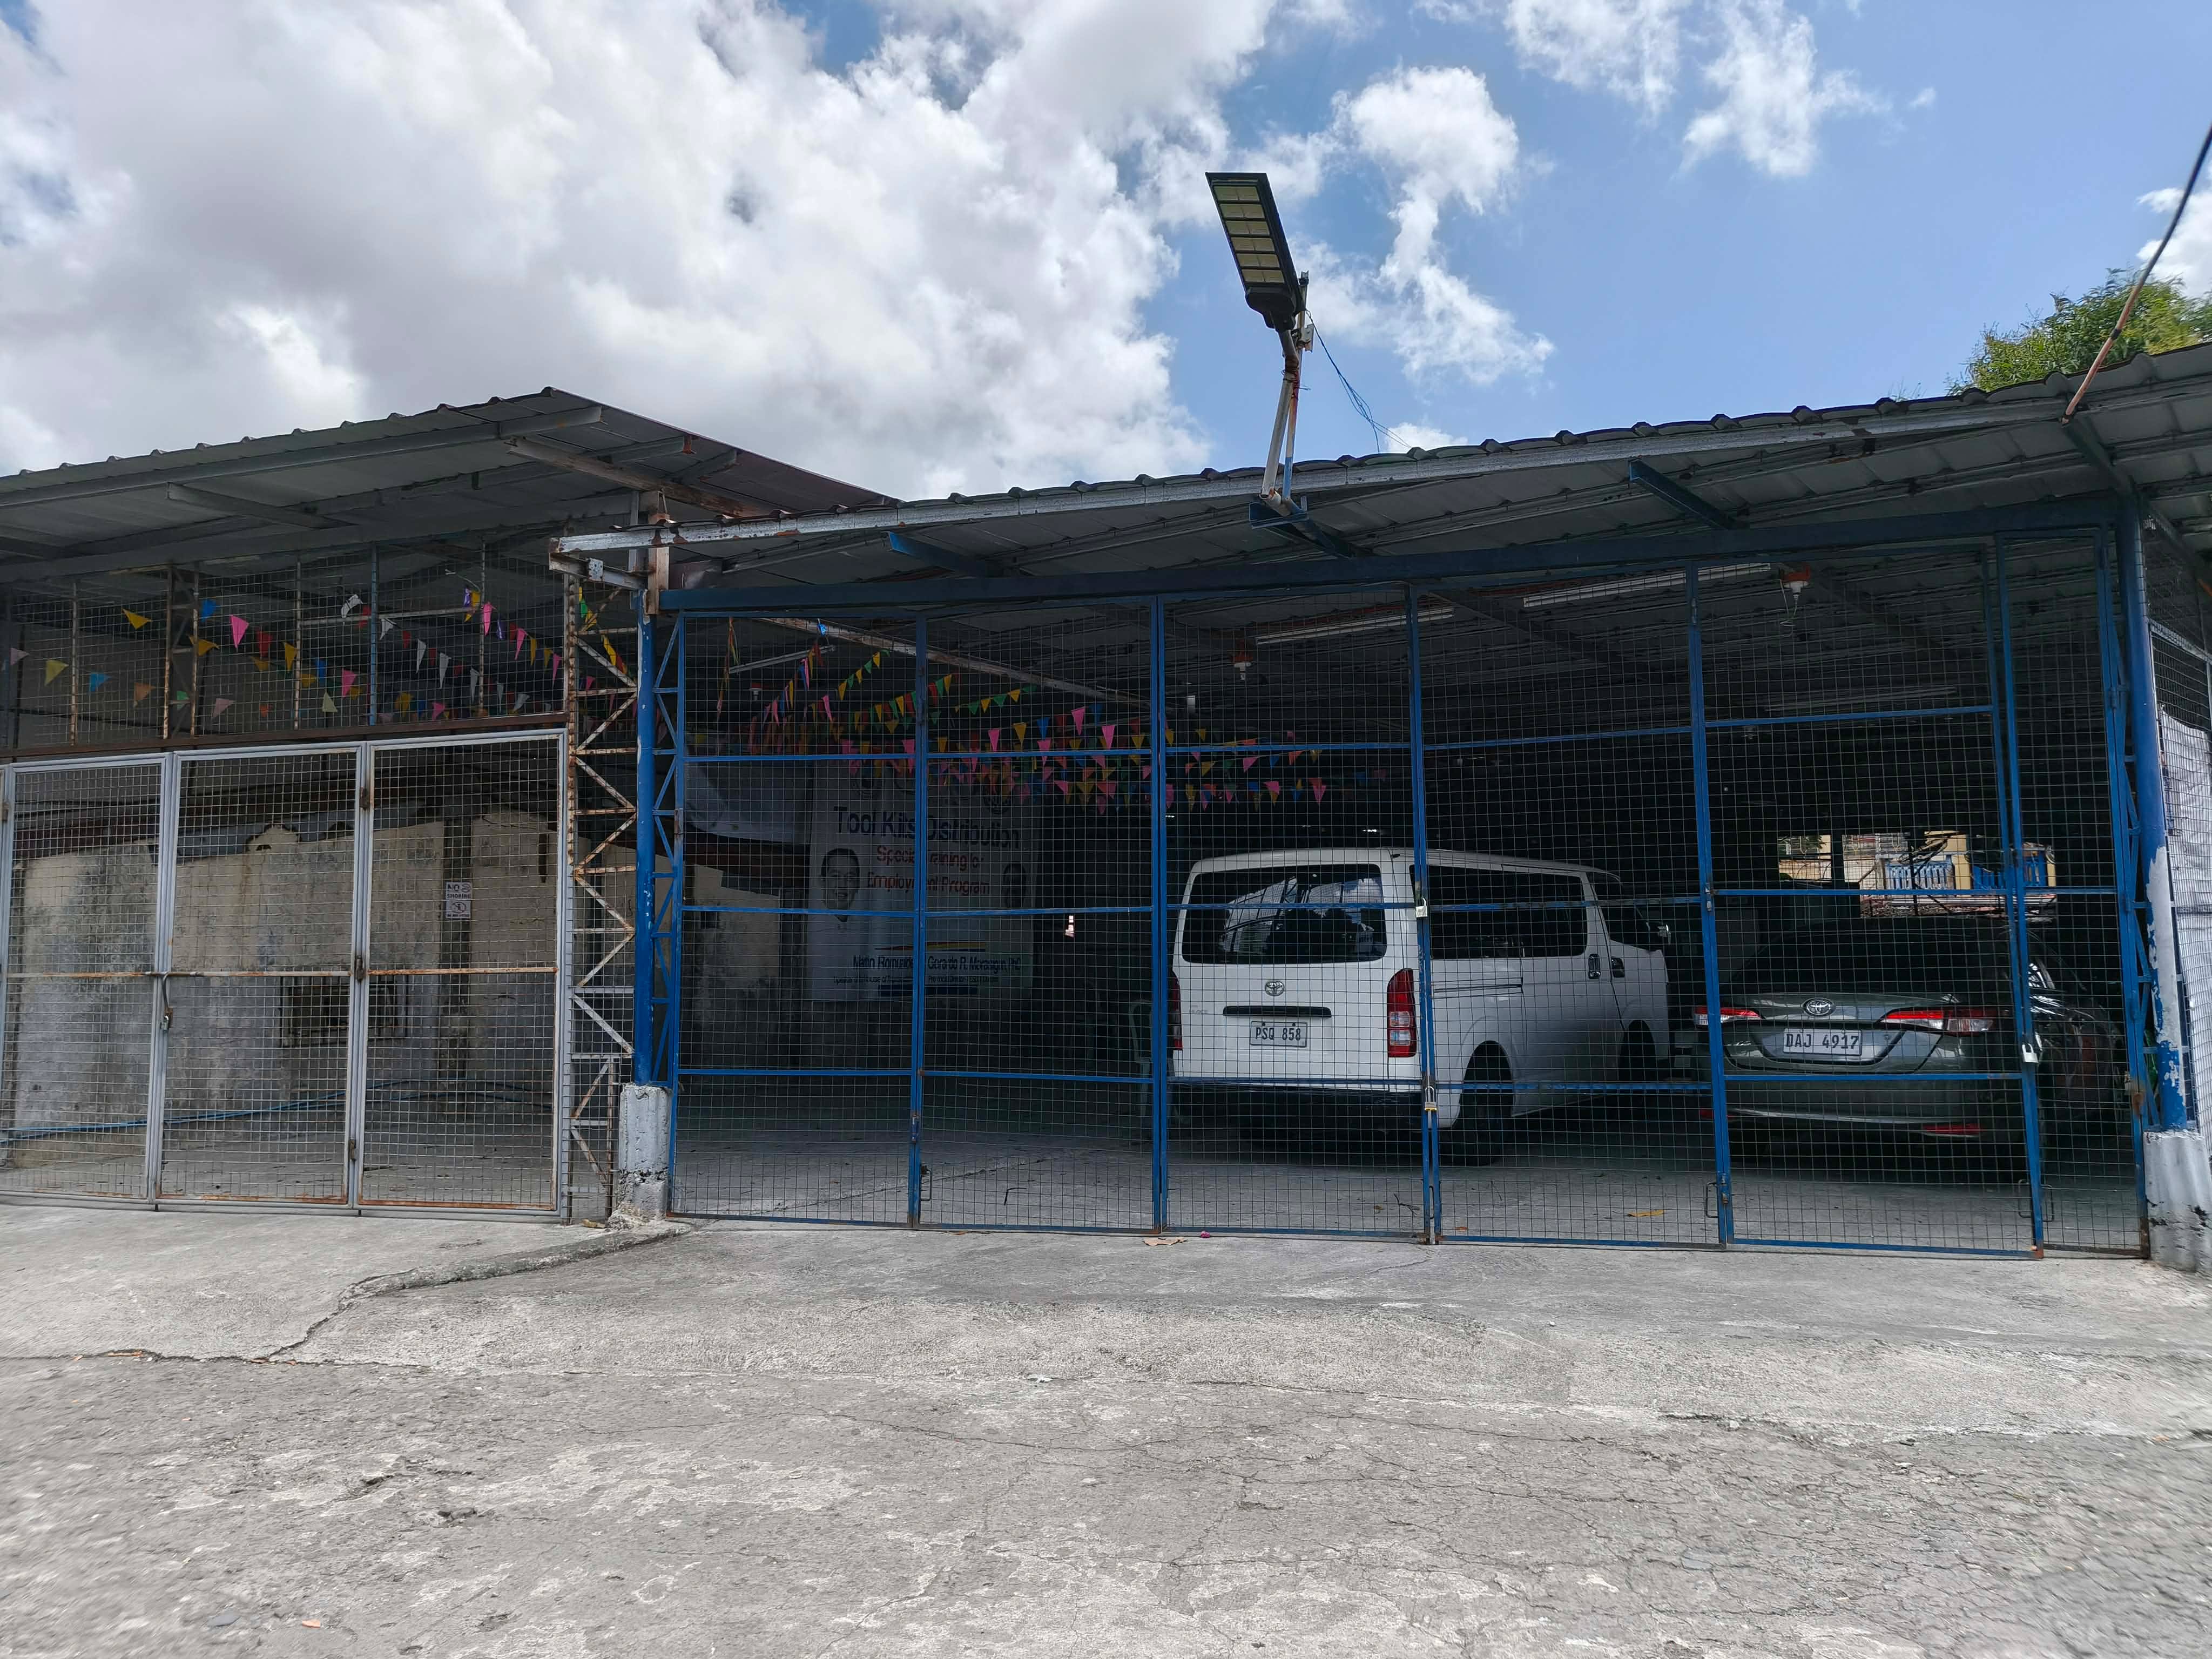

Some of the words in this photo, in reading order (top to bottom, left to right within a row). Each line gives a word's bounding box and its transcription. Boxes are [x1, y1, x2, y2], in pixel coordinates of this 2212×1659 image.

[834, 806, 875, 837] Tool
[1256, 1027, 1274, 1040] PSQ
[1282, 1028, 1301, 1041] 858
[1786, 1034, 1811, 1048] DAJ
[1822, 1034, 1859, 1049] 4917
